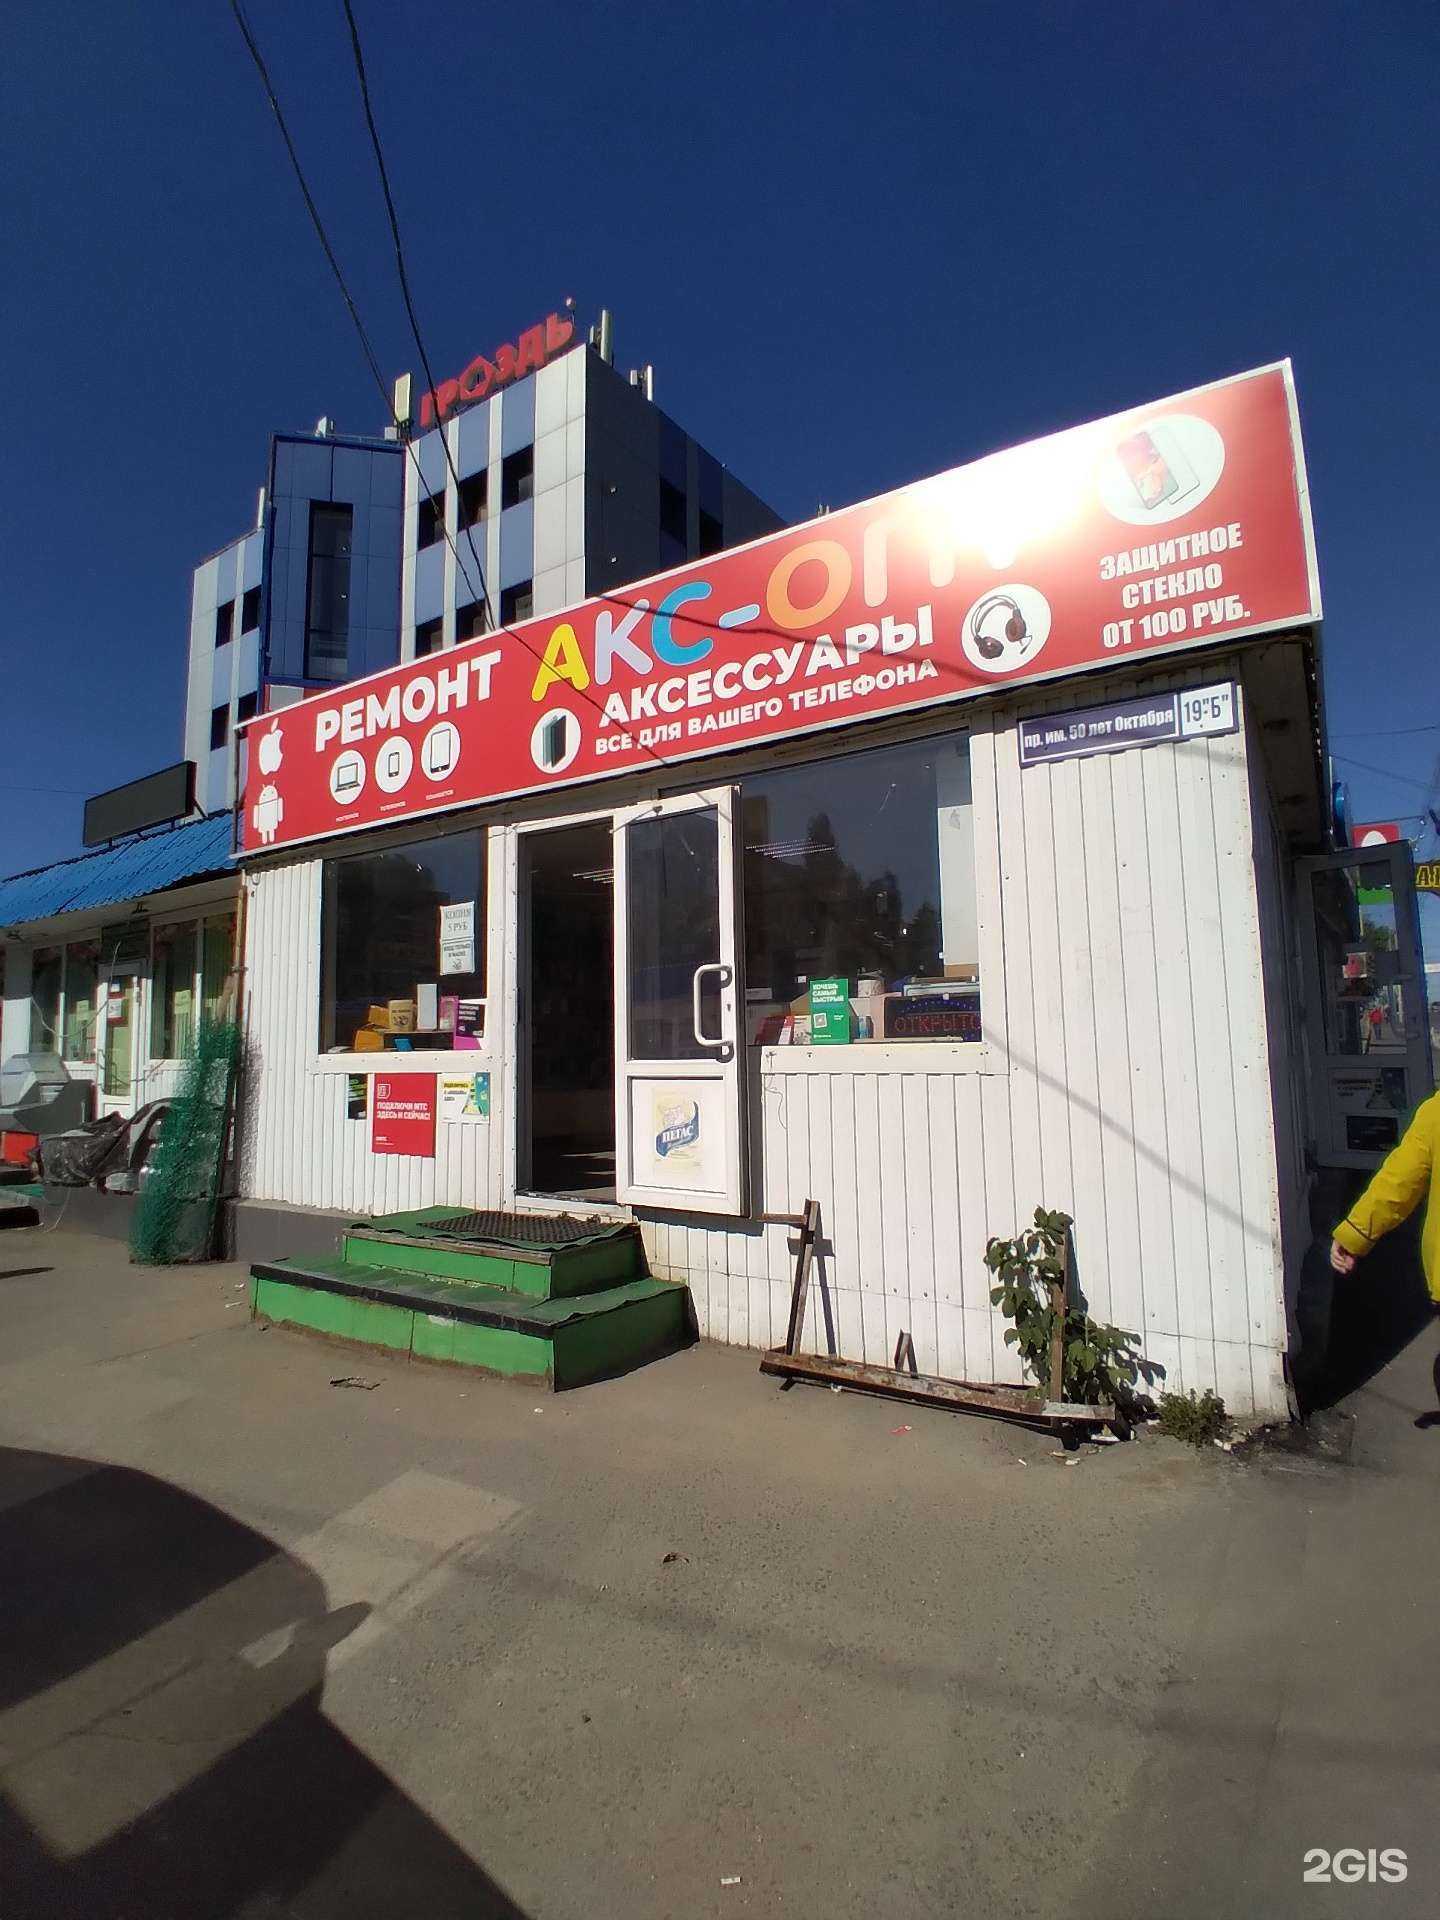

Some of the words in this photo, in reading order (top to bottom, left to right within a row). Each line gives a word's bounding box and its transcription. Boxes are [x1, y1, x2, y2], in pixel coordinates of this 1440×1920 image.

[420, 313, 575, 428] ГРОЗДЬ
[531, 490, 1020, 701] АКС-ОП
[1100, 523, 1243, 580] ЗАЩИТНОЕ
[1122, 563, 1223, 609] СТЕКЛО
[598, 605, 933, 728] АКСЕССУАРЫ
[1103, 619, 1134, 648] ОТ
[1139, 608, 1187, 640] 100
[1192, 595, 1250, 628] РУБ.
[315, 650, 501, 752] РЕМОНТ
[595, 733, 633, 756] ВСЕ
[638, 726, 681, 750] ДЛЯ
[688, 699, 782, 737] ВАШЕГО
[789, 659, 938, 712] ТЕЛЕФОНА
[1024, 734, 1043, 749] пр.
[1045, 729, 1067, 744] им.
[1069, 723, 1085, 740] 50
[1088, 720, 1112, 737] лет
[1115, 709, 1173, 732] Октября
